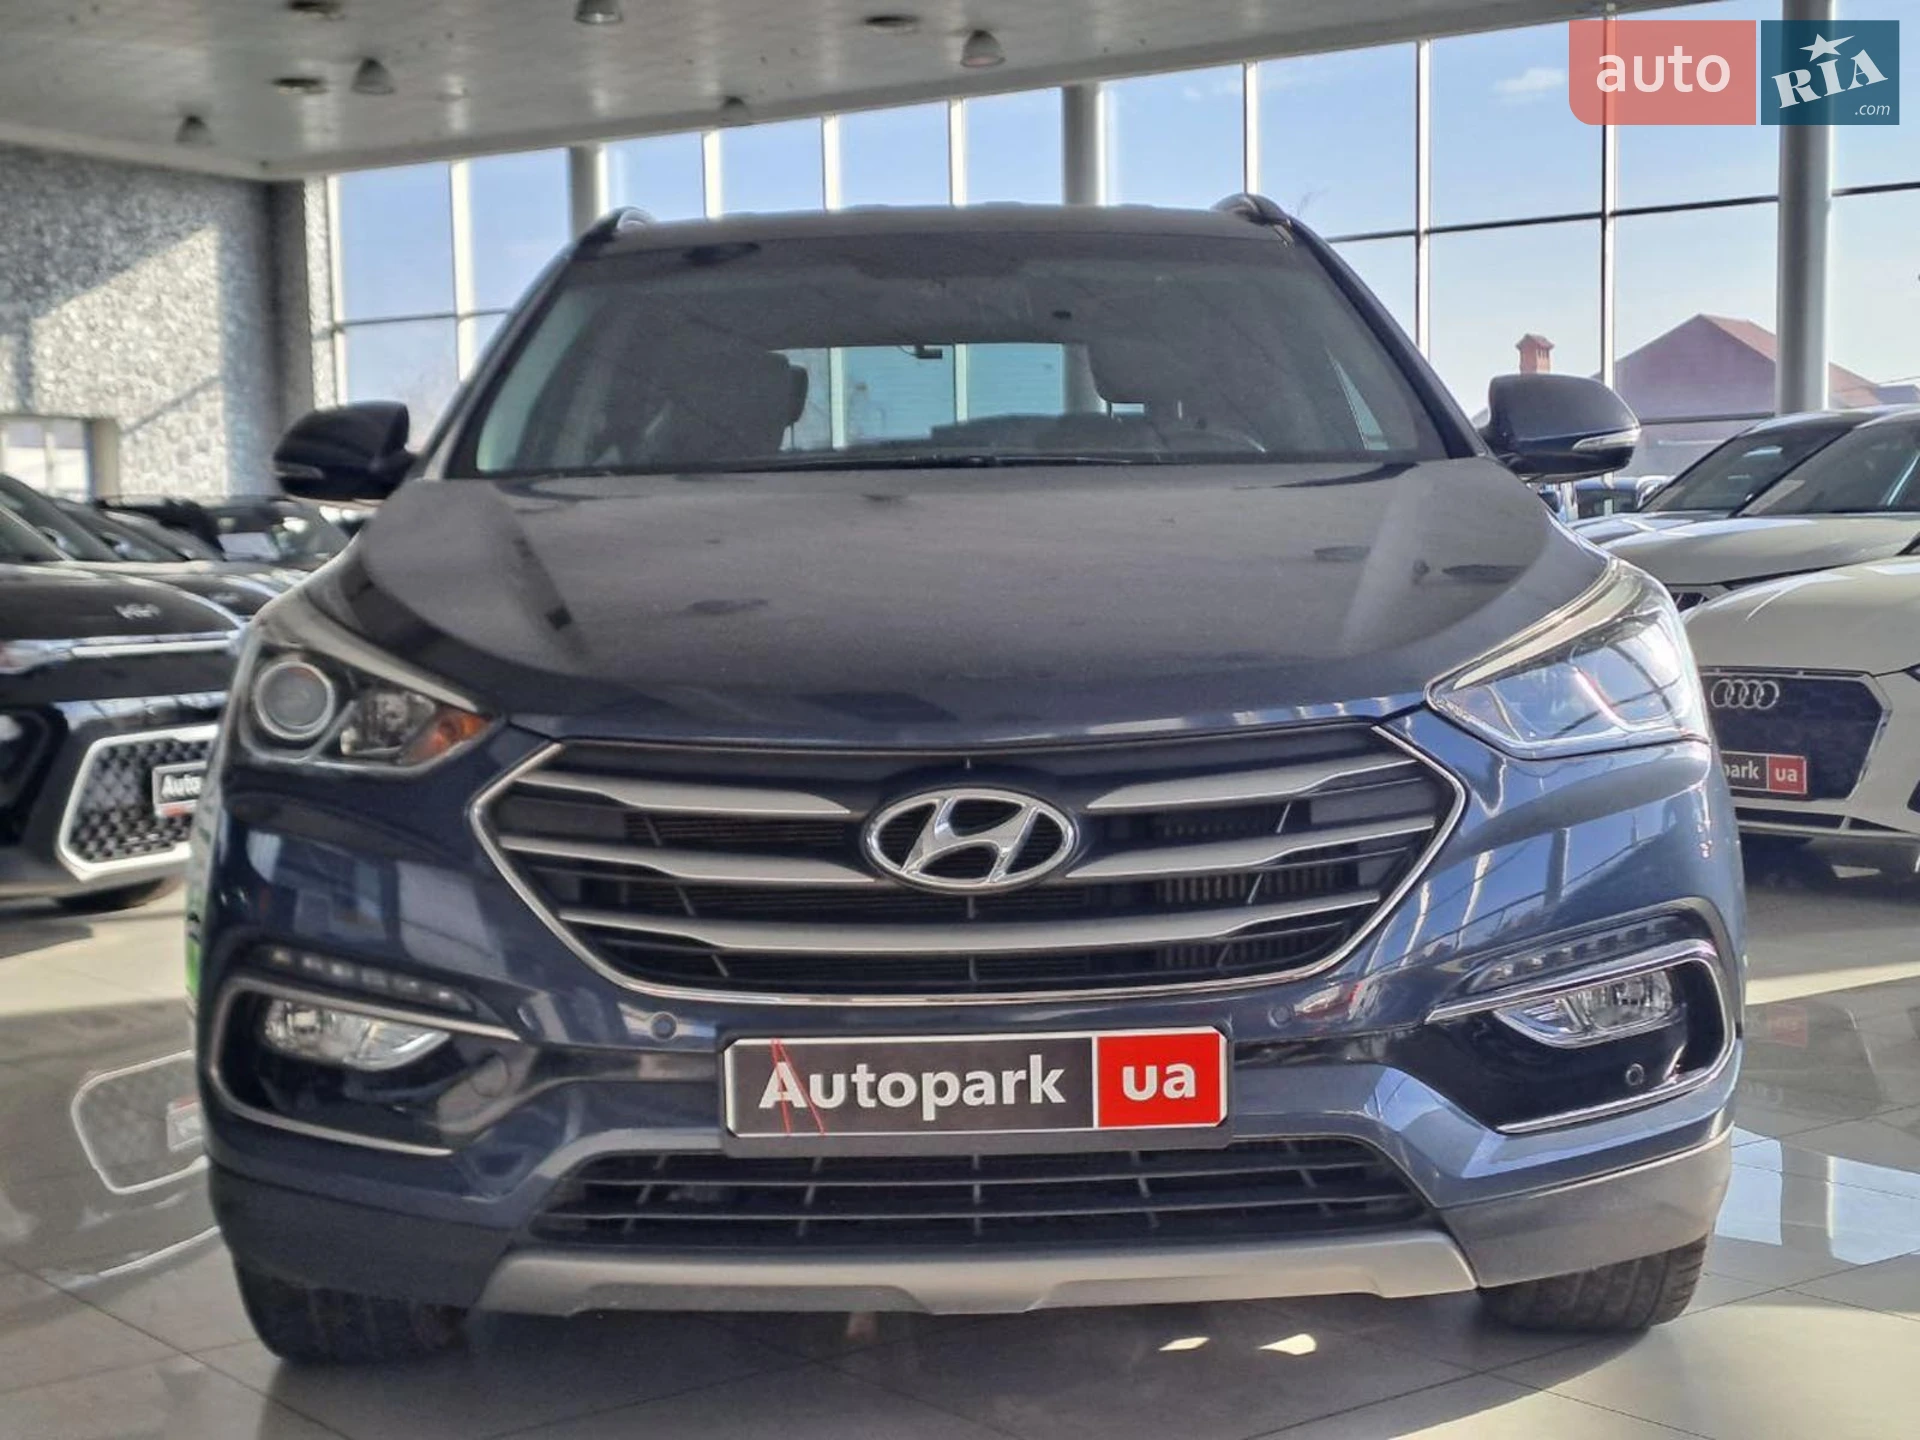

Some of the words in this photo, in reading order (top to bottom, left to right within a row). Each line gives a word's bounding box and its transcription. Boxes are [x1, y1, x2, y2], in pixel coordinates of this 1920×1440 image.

[1775, 767, 1798, 783] ua
[758, 1054, 1066, 1121] Autopark
[1121, 1062, 1196, 1101] ua
